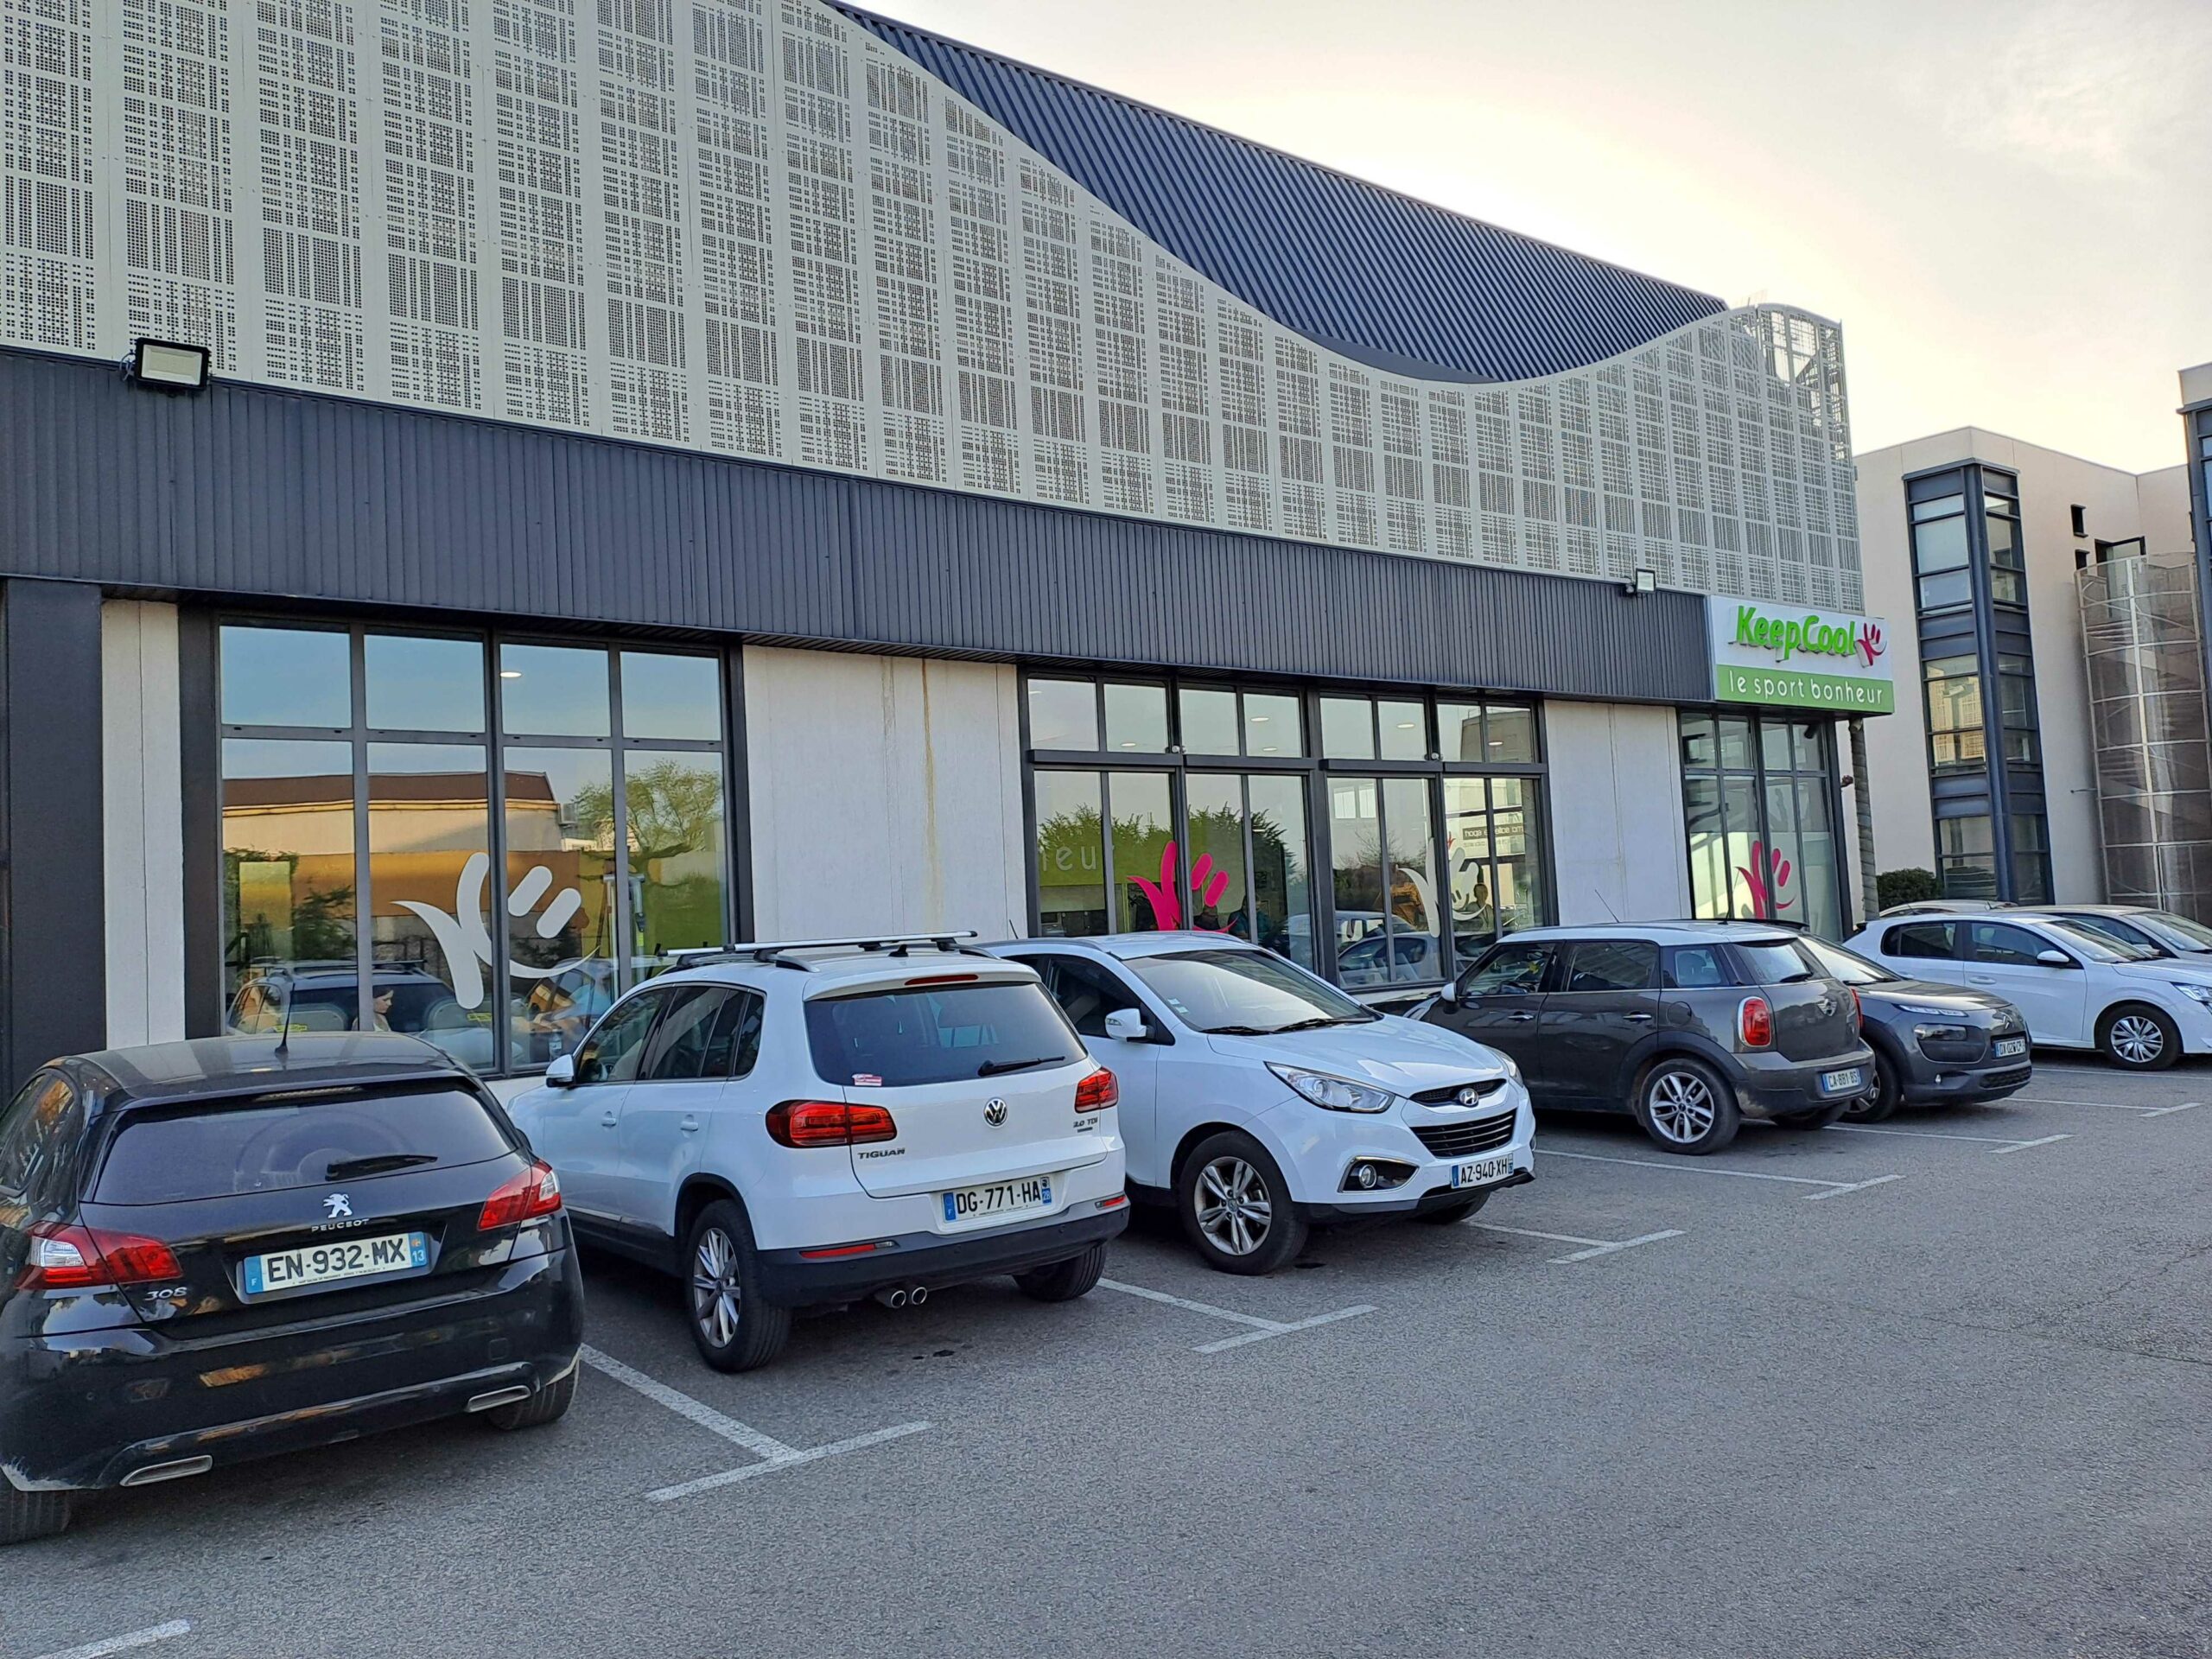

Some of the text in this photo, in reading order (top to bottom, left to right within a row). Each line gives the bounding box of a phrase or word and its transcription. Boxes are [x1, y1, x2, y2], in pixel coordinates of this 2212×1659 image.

[1736, 605, 1856, 660] KeepCool
[1729, 670, 1883, 704] le sport bonheur
[857, 1147, 905, 1159] TIGUAN
[1460, 1158, 1508, 1184] AZ-940-XH
[956, 1180, 1041, 1215] DG-771-HA
[311, 1218, 370, 1232] PEUGEOT
[267, 1238, 406, 1283] EN-932-MX
[412, 1249, 425, 1262] 13
[143, 1287, 188, 1300] 308
